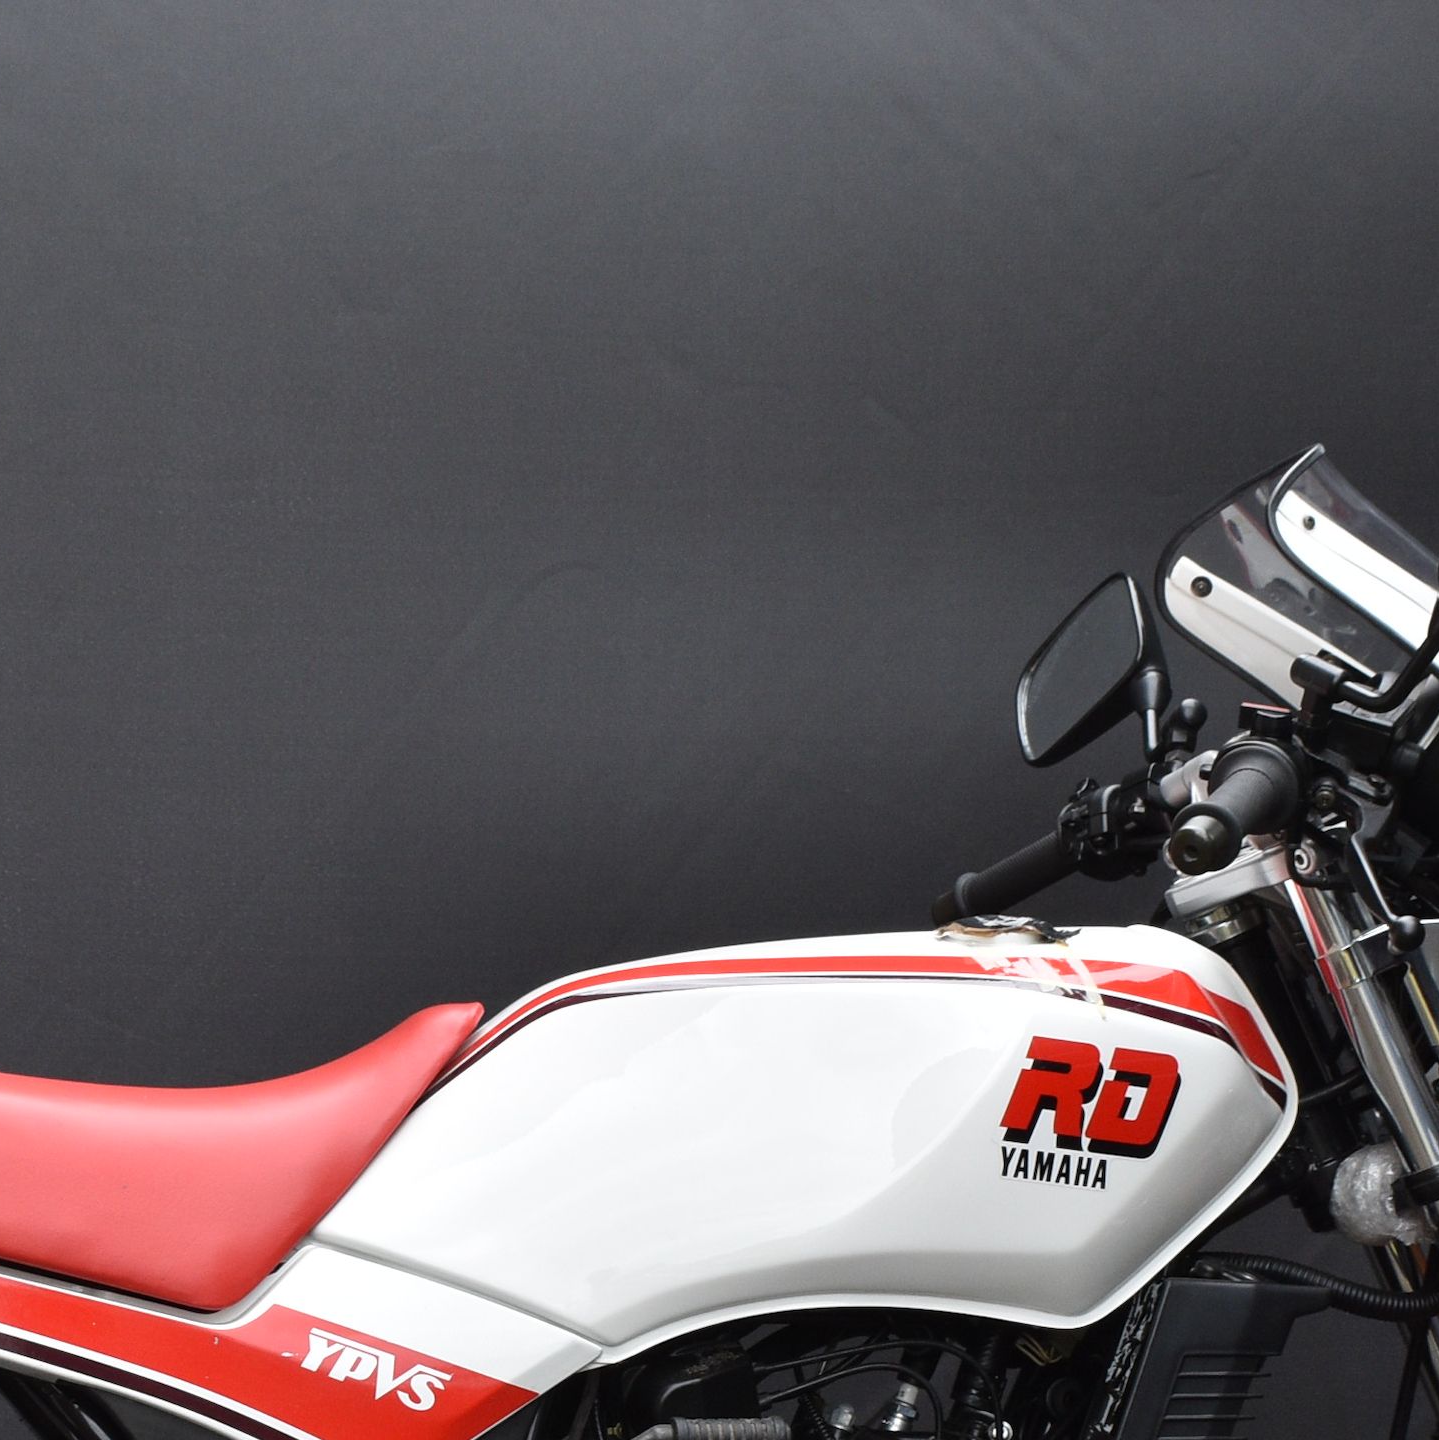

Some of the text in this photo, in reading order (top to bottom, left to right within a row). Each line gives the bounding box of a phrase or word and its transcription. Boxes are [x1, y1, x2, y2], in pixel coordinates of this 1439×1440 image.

[999, 1035, 1181, 1159] RD
[1001, 1146, 1107, 1190] YAMAHA
[300, 1327, 454, 1412] YPVS
